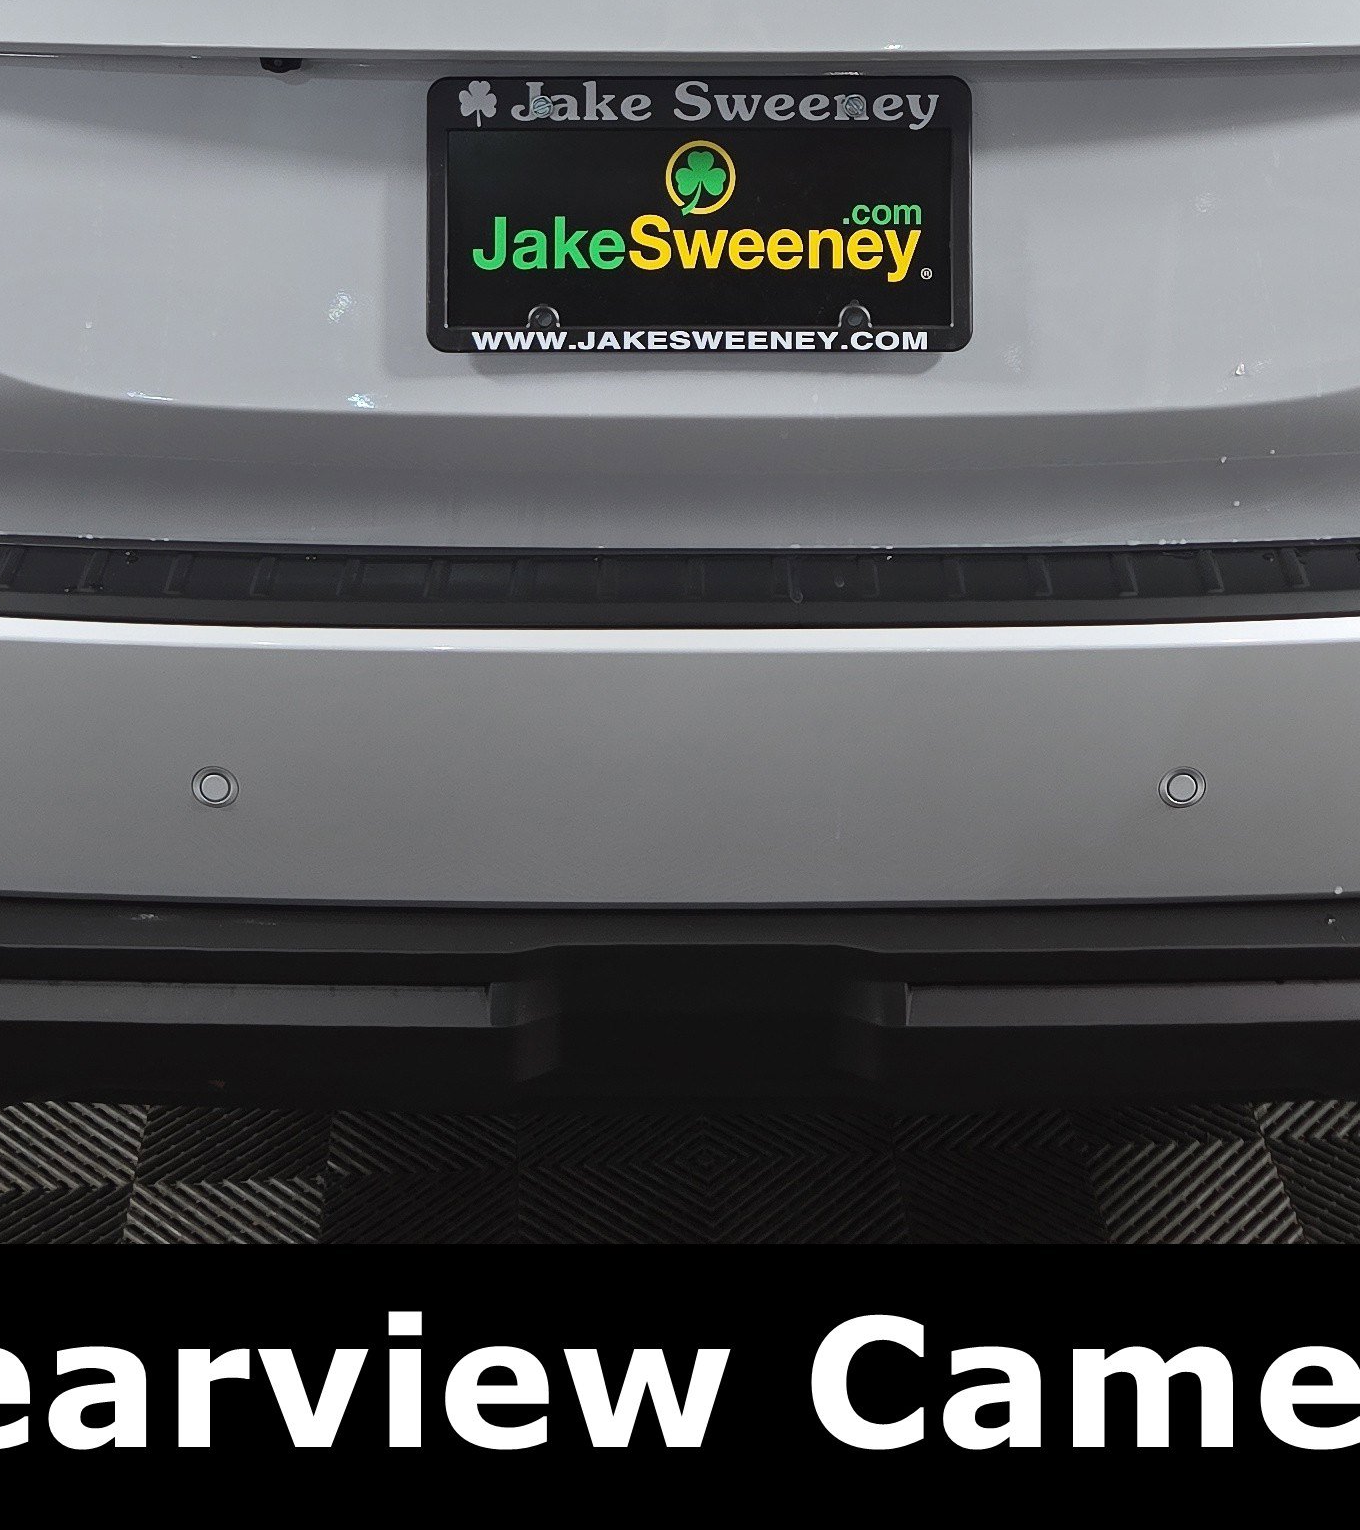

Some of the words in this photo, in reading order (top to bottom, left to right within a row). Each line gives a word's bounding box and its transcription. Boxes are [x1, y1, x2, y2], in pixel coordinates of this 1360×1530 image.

[511, 81, 652, 122] Jake
[673, 81, 940, 131] Sweeney
[843, 204, 922, 226] .com
[472, 330, 929, 351] WWW.JAKESWEENEY.COM
